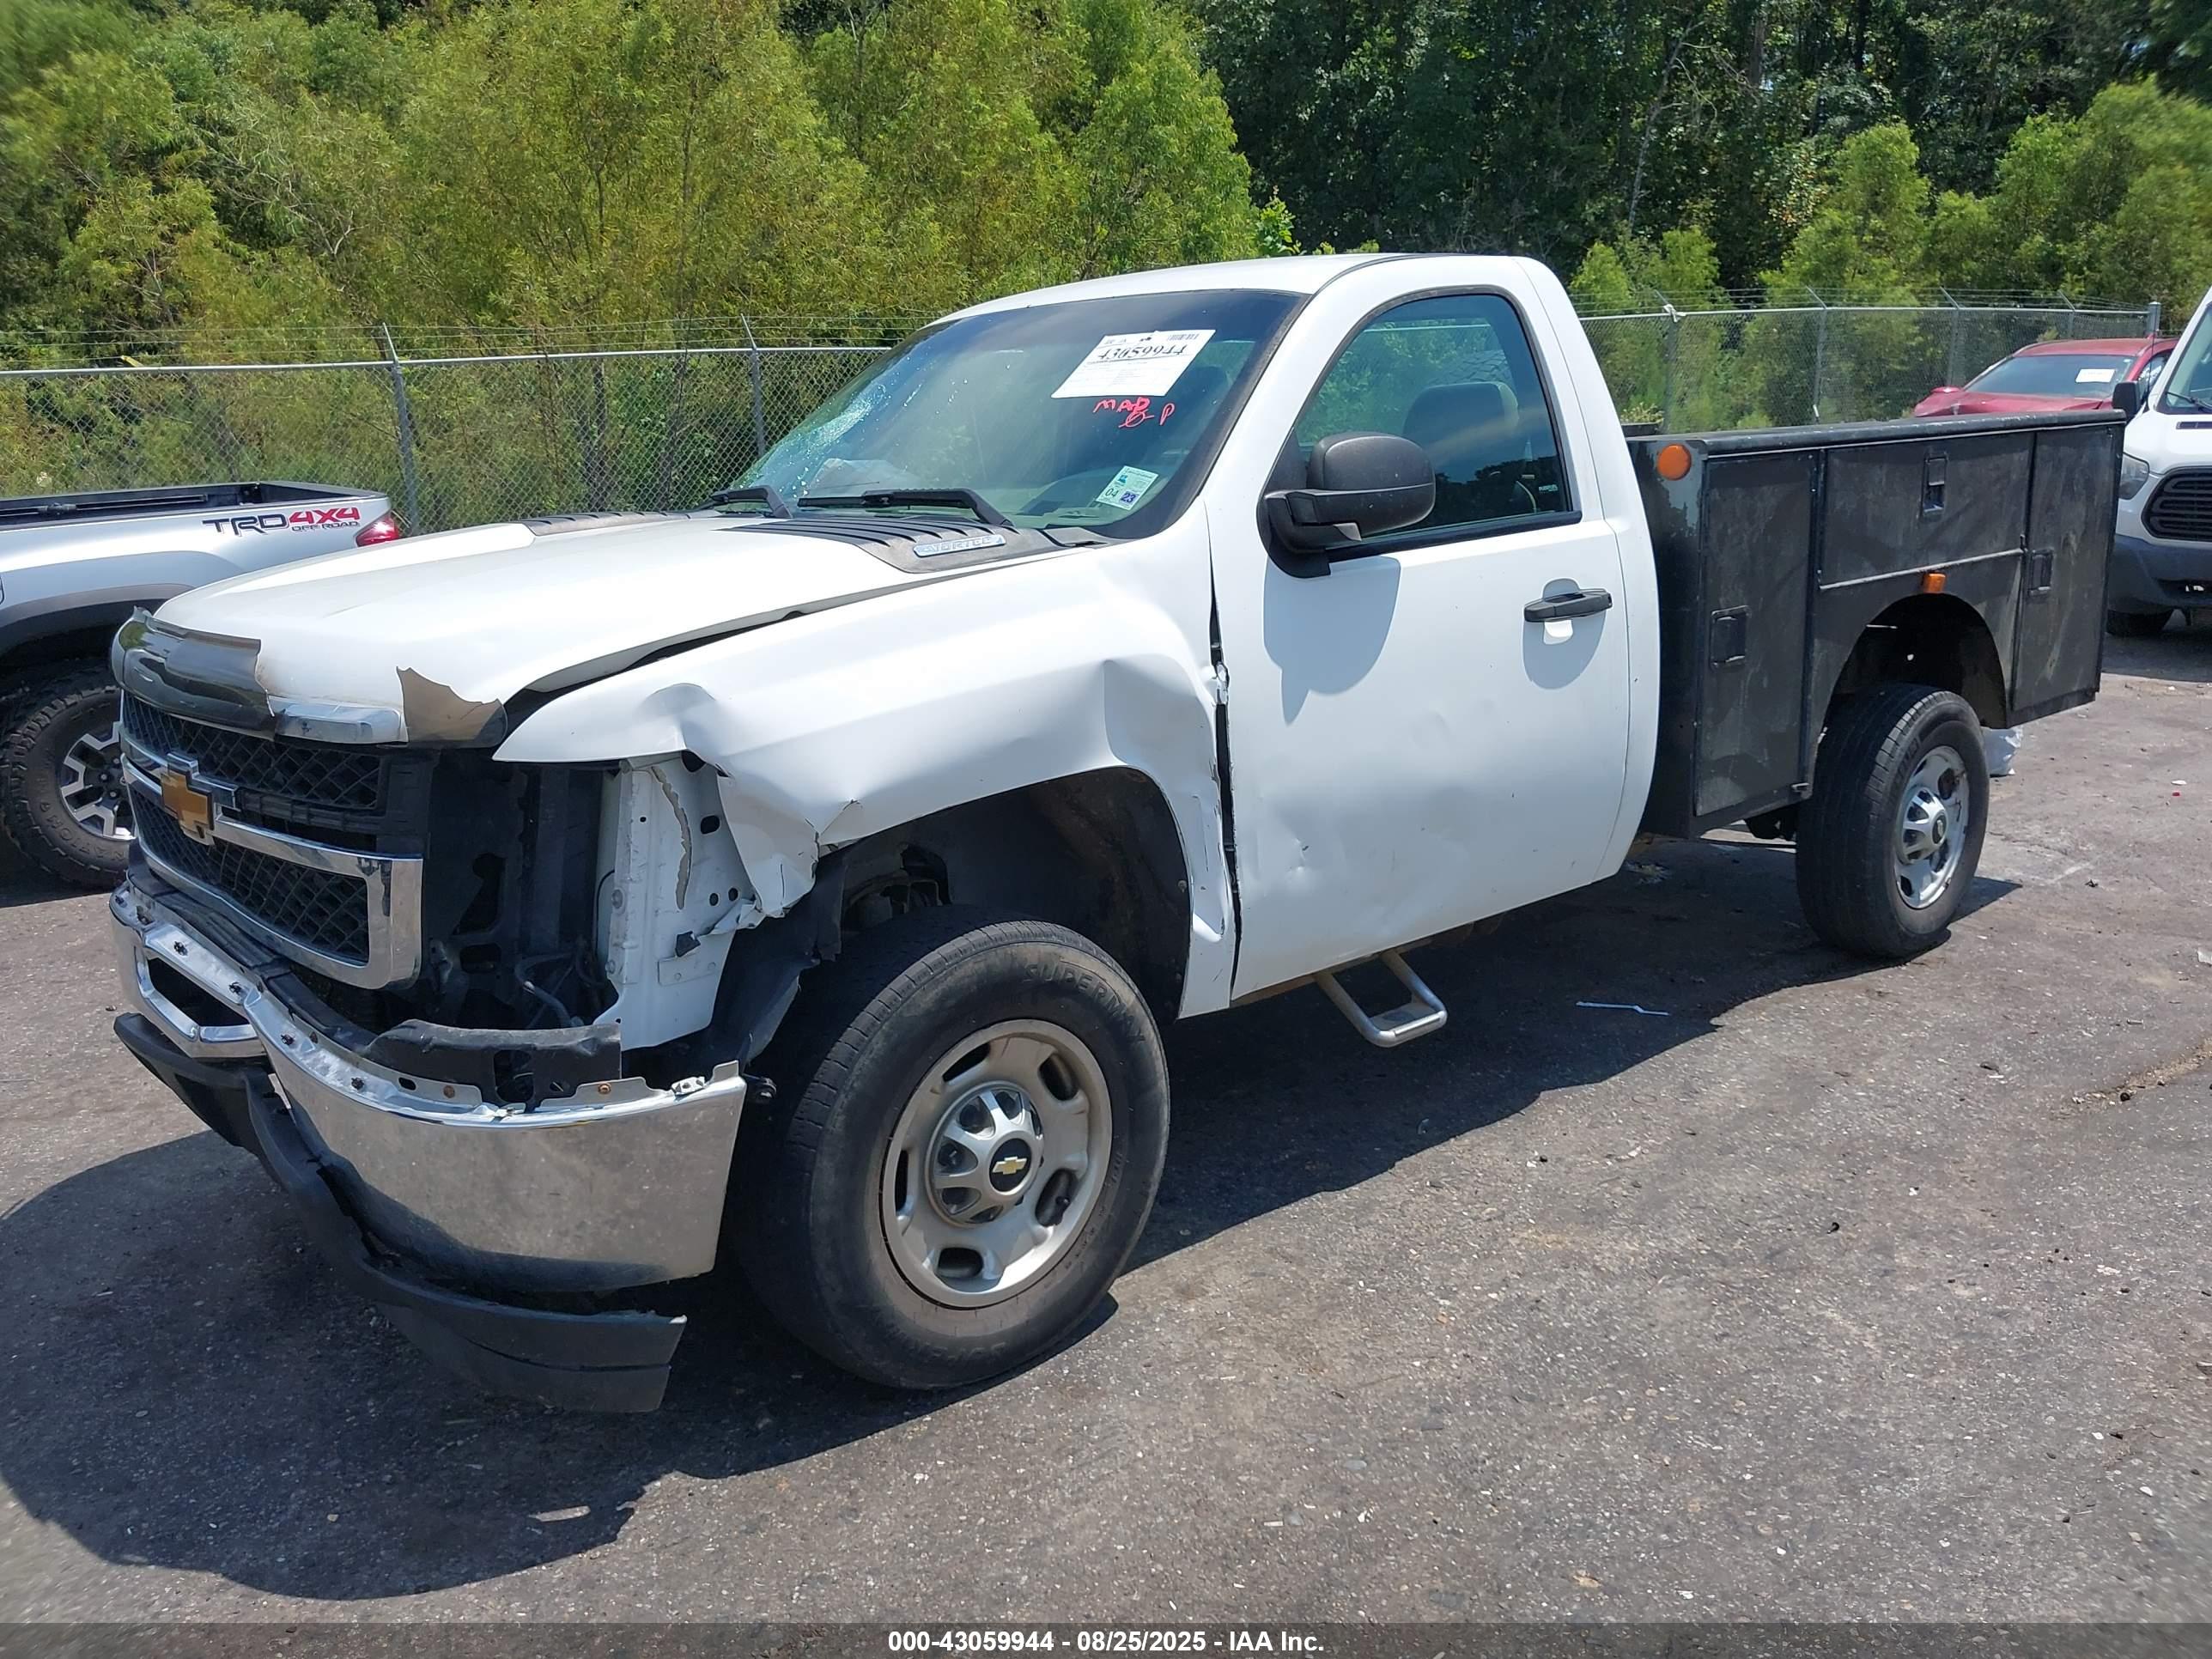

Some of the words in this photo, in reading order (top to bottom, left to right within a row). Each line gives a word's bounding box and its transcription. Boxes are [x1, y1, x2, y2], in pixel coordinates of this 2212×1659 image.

[1098, 344, 1188, 360] 43059944
[1120, 492, 1136, 503] 23
[202, 514, 289, 537] TRD
[323, 520, 360, 531] ROAD
